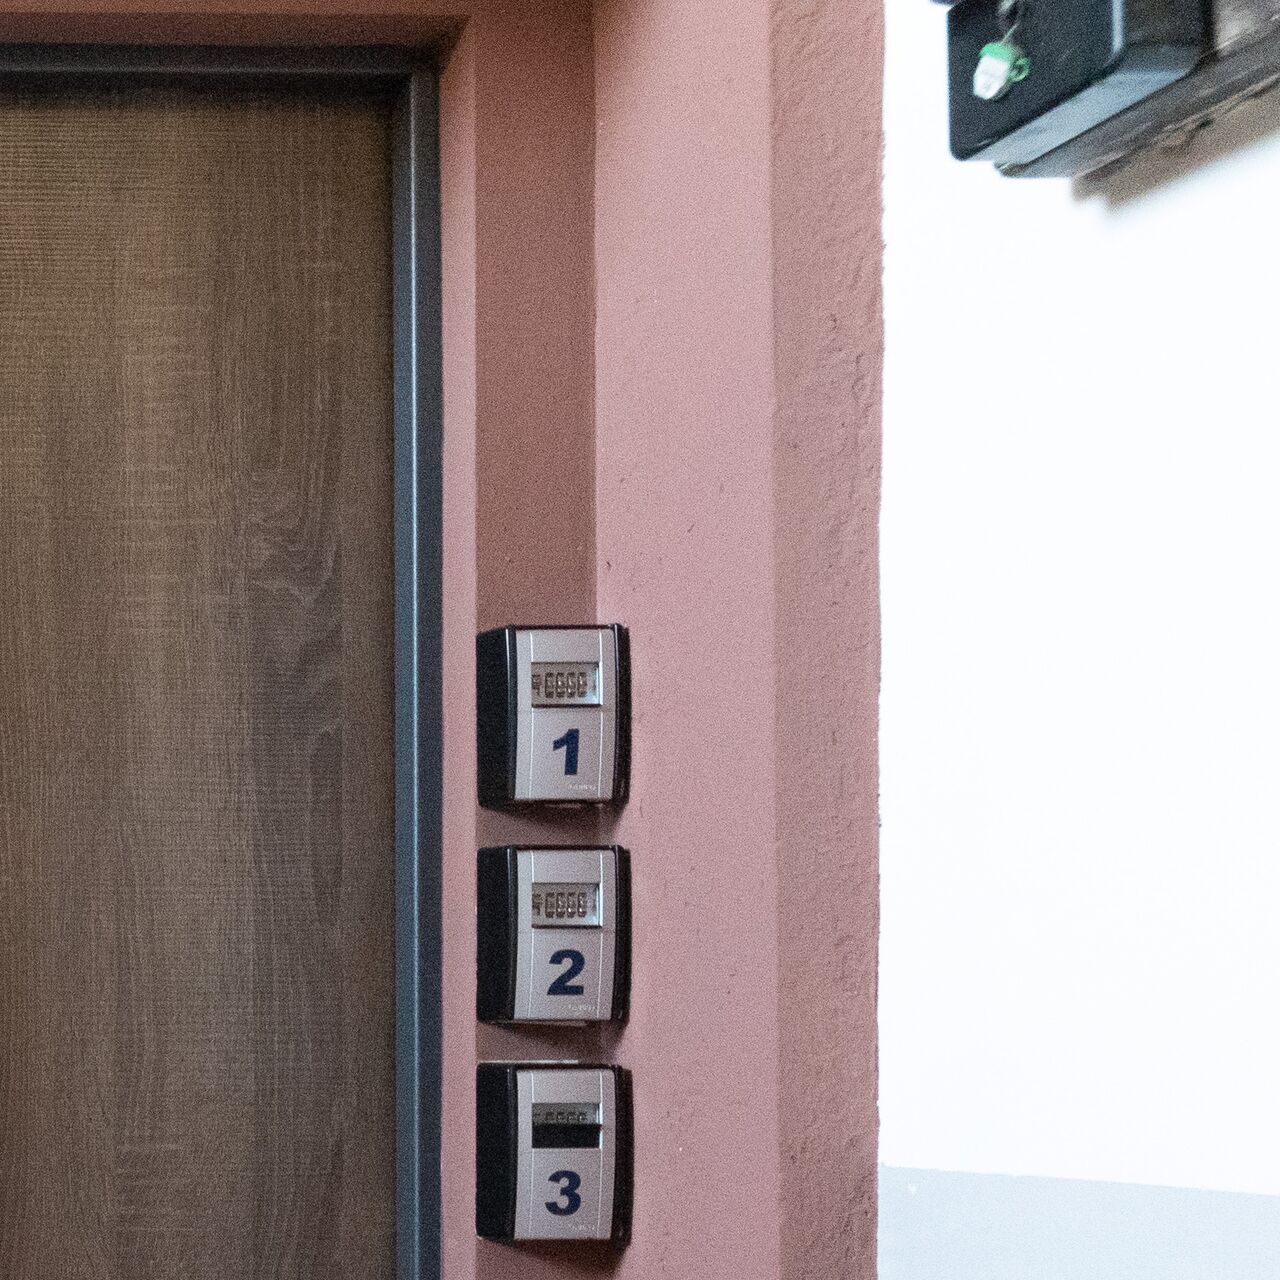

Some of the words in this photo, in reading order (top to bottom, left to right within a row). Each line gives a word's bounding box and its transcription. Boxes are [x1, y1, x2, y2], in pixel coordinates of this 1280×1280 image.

[552, 727, 580, 776] 1
[546, 948, 586, 996] 2
[544, 1169, 582, 1217] 3
